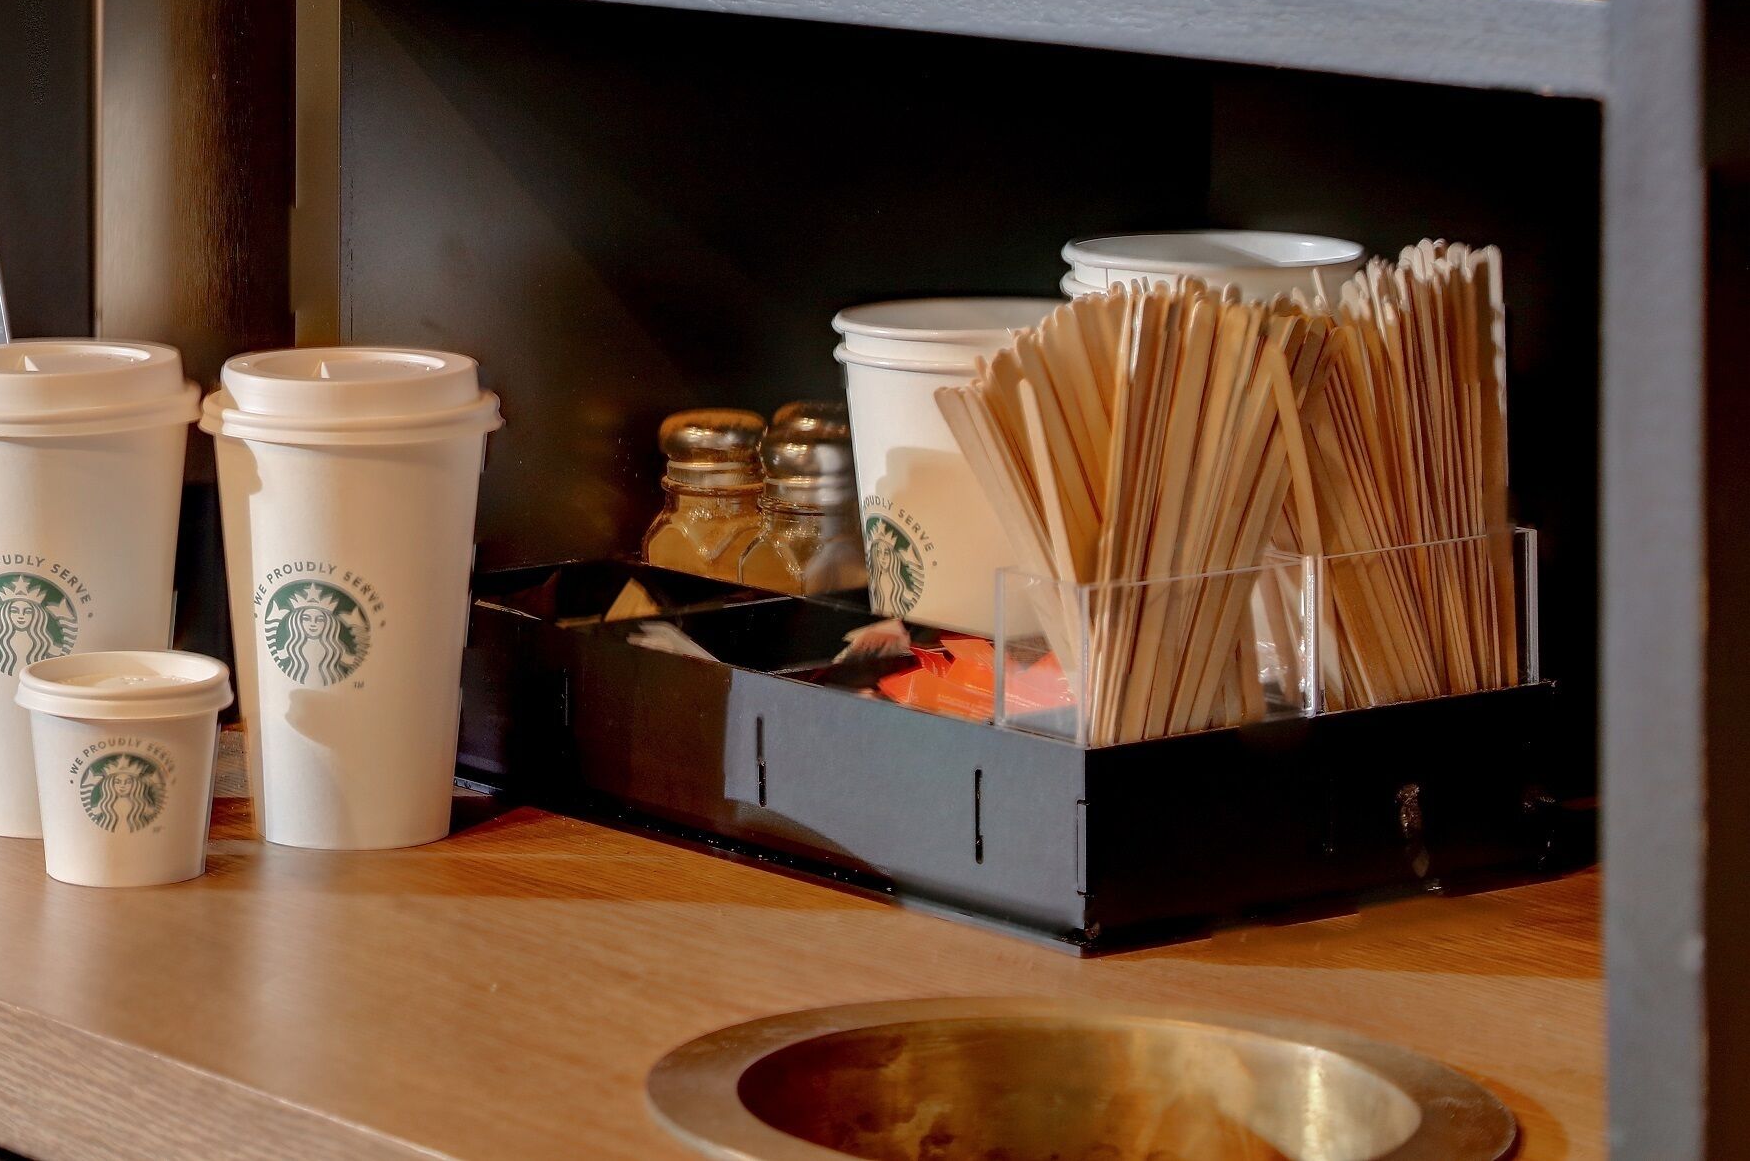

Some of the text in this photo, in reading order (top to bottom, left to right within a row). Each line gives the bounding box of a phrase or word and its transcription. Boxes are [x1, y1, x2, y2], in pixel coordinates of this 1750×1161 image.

[898, 509, 934, 552] SERVE
[50, 564, 92, 605] SERVE
[253, 561, 384, 613] WE PROUDLY SERVE
[70, 757, 84, 776] WE
[82, 737, 142, 758] PROUDLY
